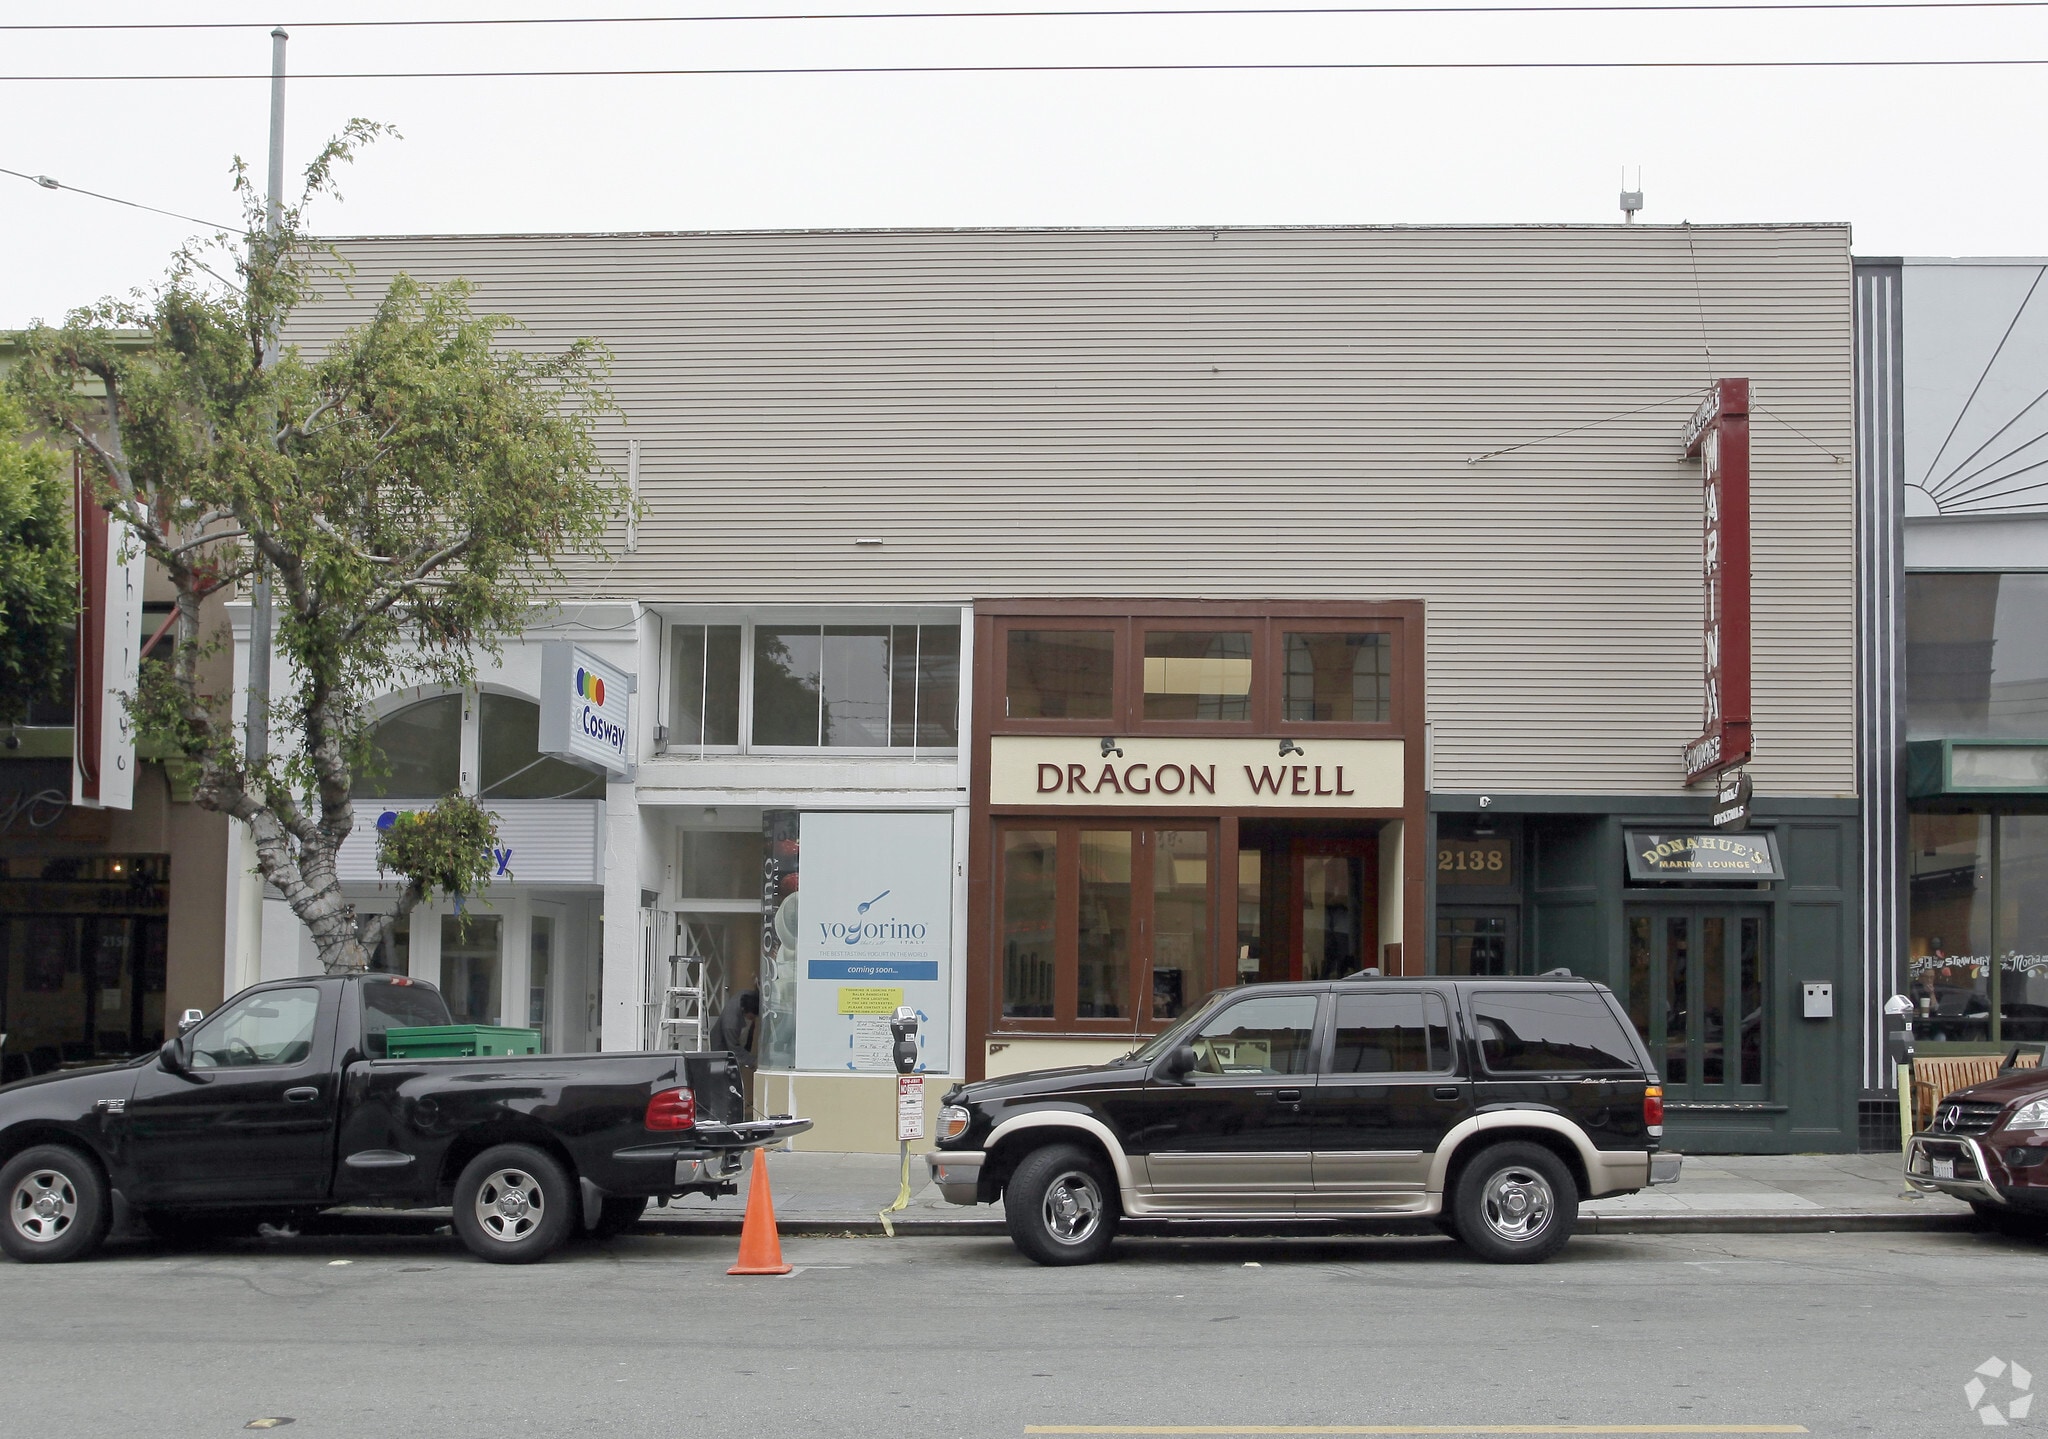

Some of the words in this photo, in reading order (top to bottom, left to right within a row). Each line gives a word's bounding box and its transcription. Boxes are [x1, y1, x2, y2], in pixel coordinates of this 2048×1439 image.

[1702, 428, 1718, 724] MARINA
[1037, 763, 1216, 794] DRAGON
[1244, 765, 1355, 796] WELL
[1438, 850, 1503, 871] 2138
[1642, 837, 1764, 865] DONAHUE'S
[1659, 861, 1703, 869] MARINA
[1707, 861, 1750, 869] LOUNGE
[820, 918, 926, 945] yogorino
[848, 966, 874, 975] coming
